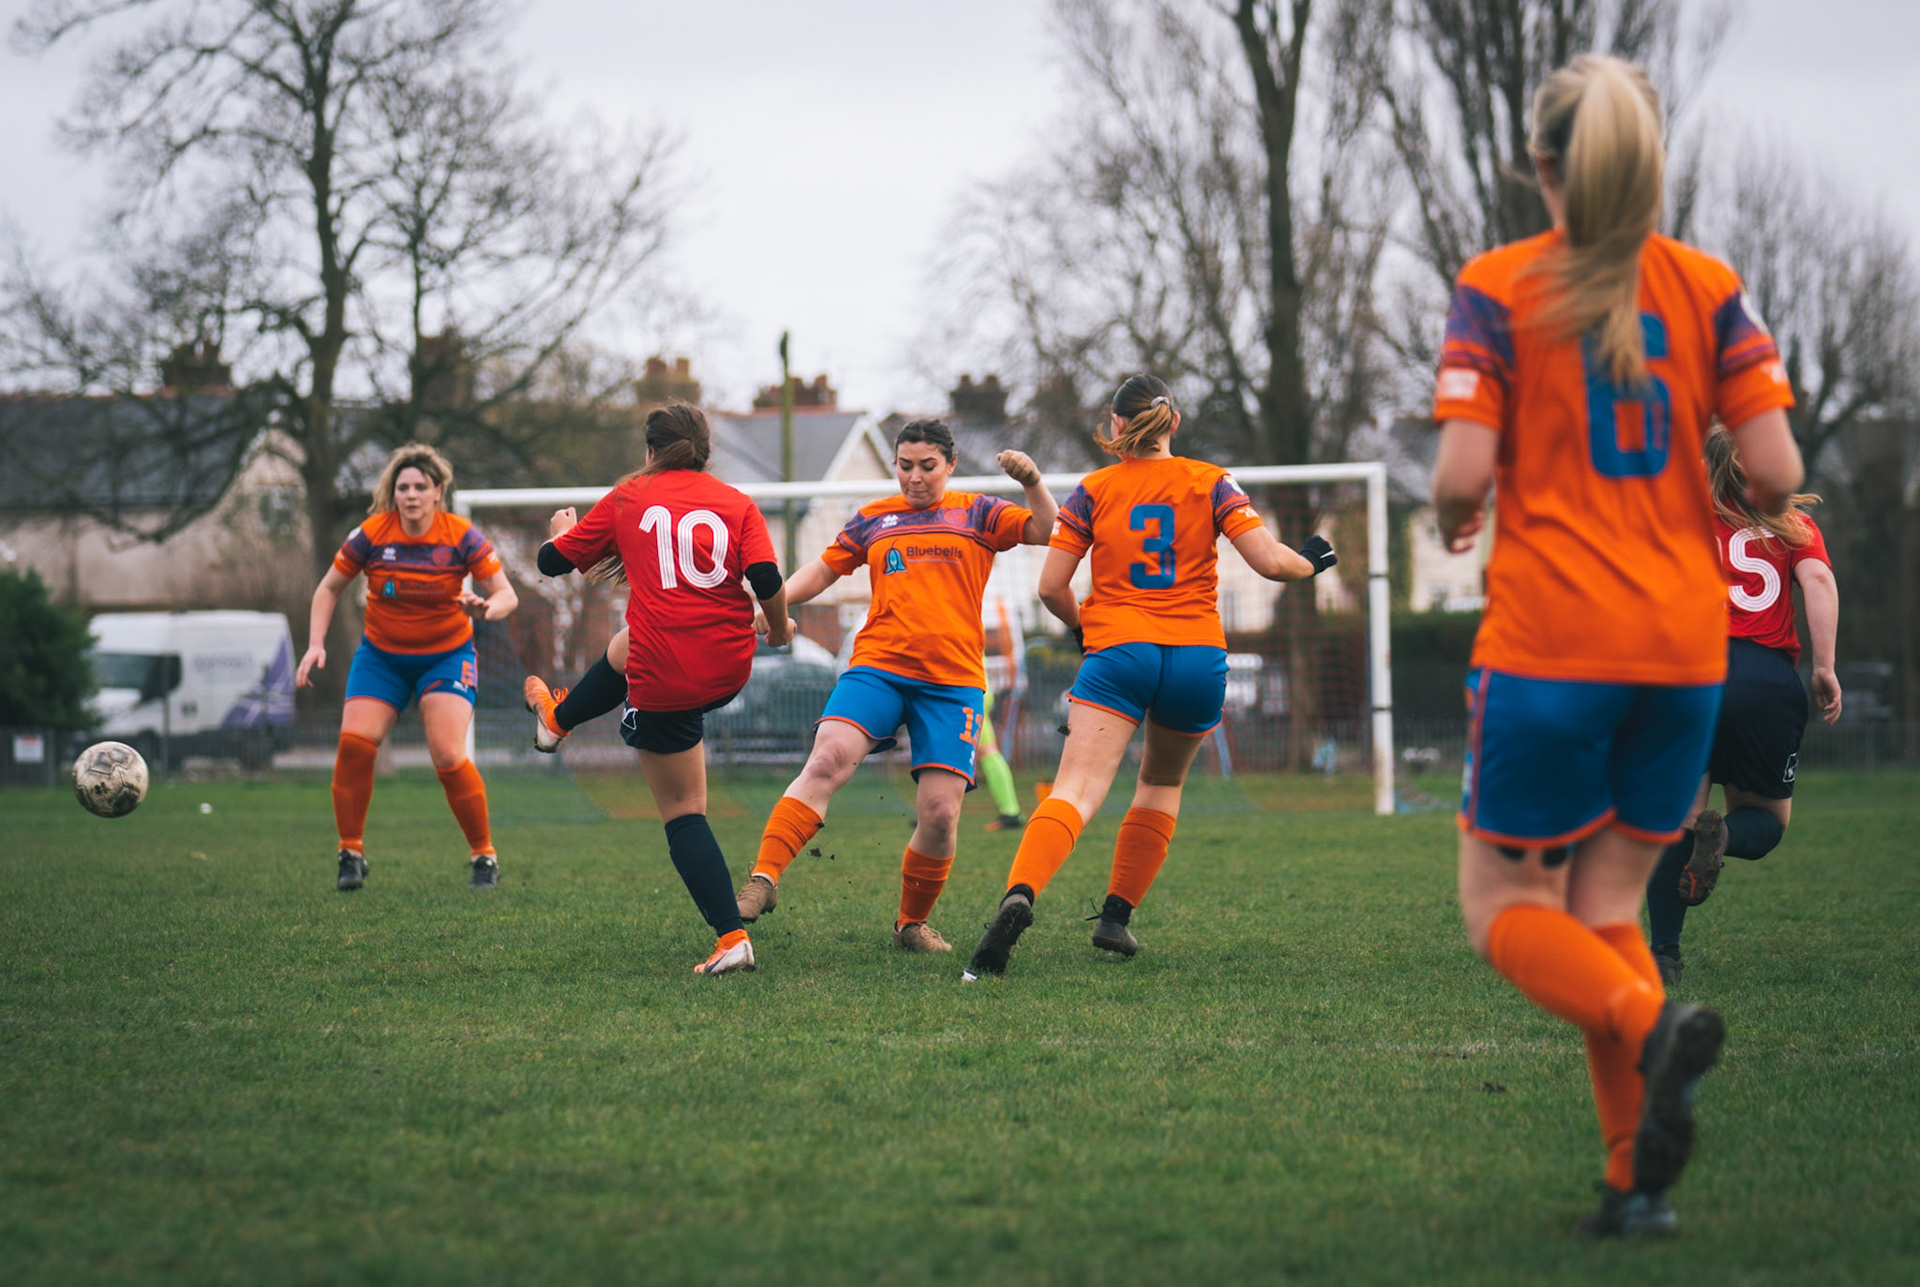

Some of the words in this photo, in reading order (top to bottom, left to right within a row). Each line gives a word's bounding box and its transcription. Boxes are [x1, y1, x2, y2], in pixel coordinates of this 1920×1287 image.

[1582, 311, 1670, 480] 6
[638, 505, 729, 590] 10
[906, 545, 963, 559] Bluebells
[1130, 504, 1176, 589] 3
[1715, 526, 1781, 612] 5
